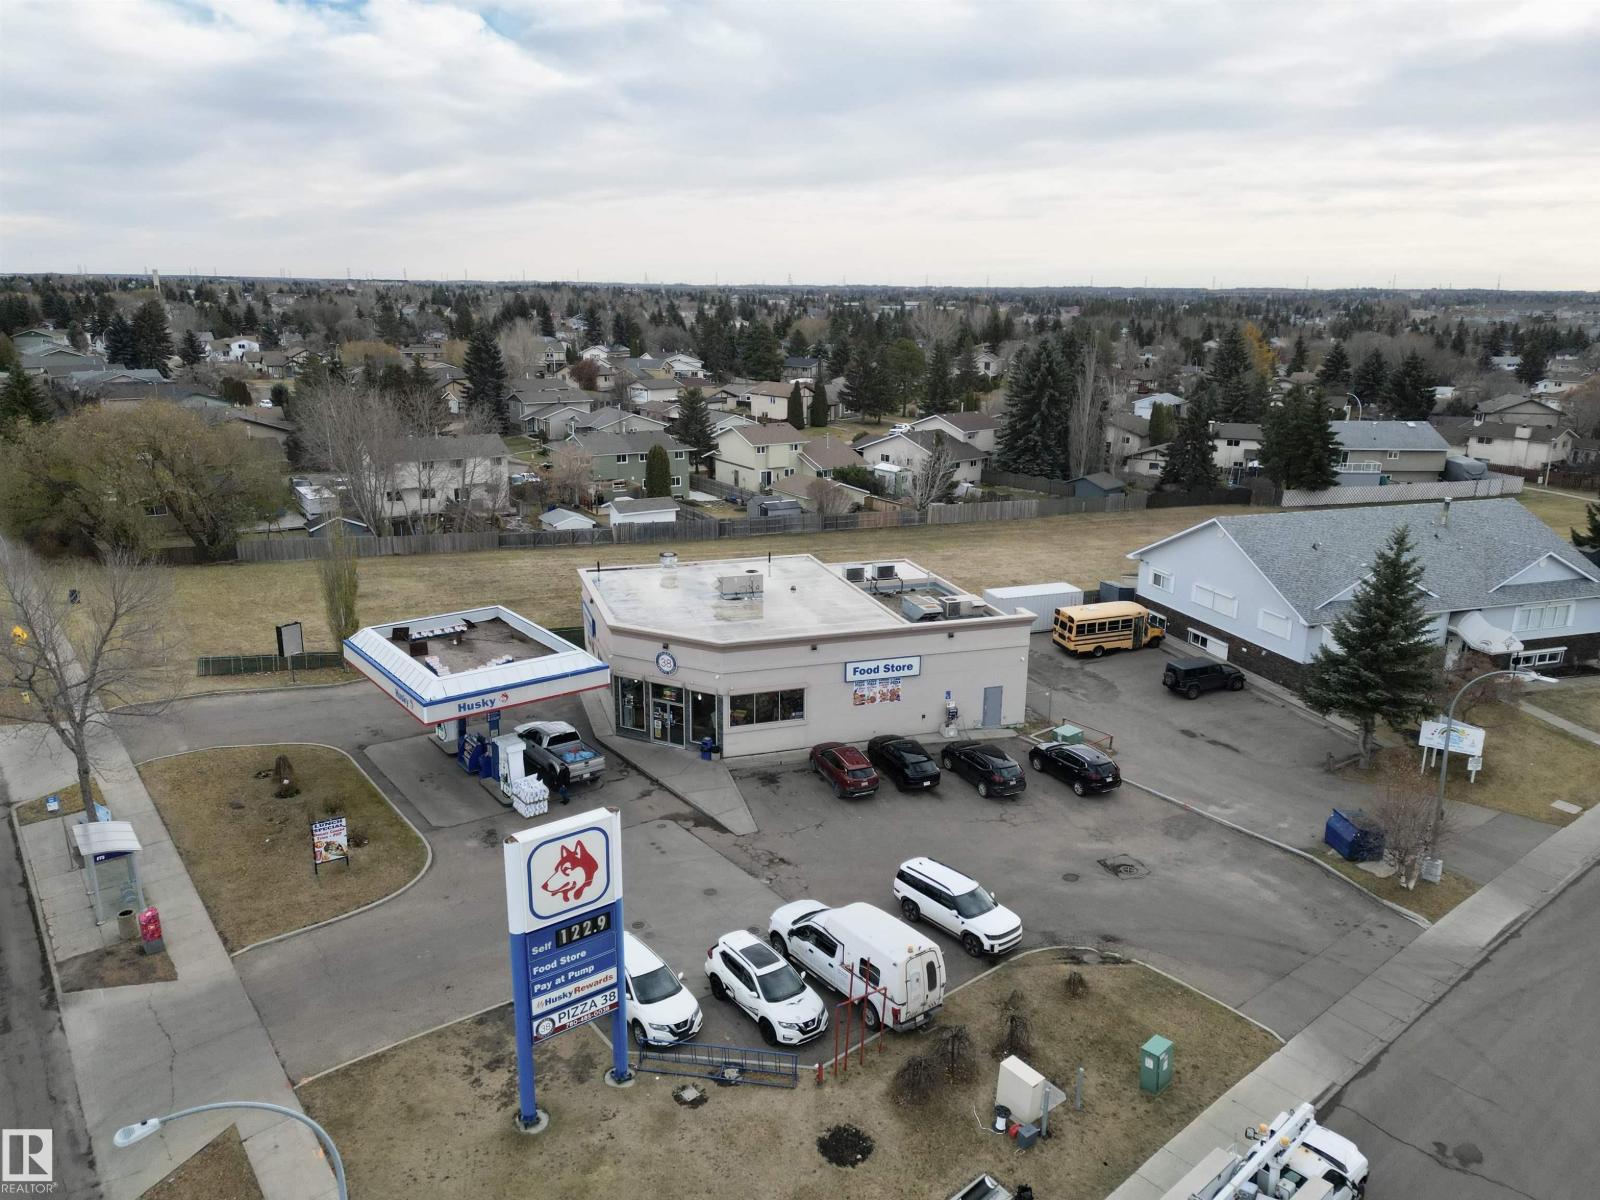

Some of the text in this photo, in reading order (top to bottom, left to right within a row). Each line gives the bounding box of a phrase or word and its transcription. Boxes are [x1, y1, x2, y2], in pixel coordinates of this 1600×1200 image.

[852, 663, 913, 676] Food Store
[457, 698, 496, 712] Husky
[314, 819, 343, 828] LUNCH
[560, 915, 606, 944] 122.9
[531, 941, 552, 955] Self
[532, 950, 587, 975] Food Store
[533, 965, 595, 993] Pay at Pump
[557, 991, 617, 1024] PIZZA 38
[540, 1022, 551, 1033] 38
